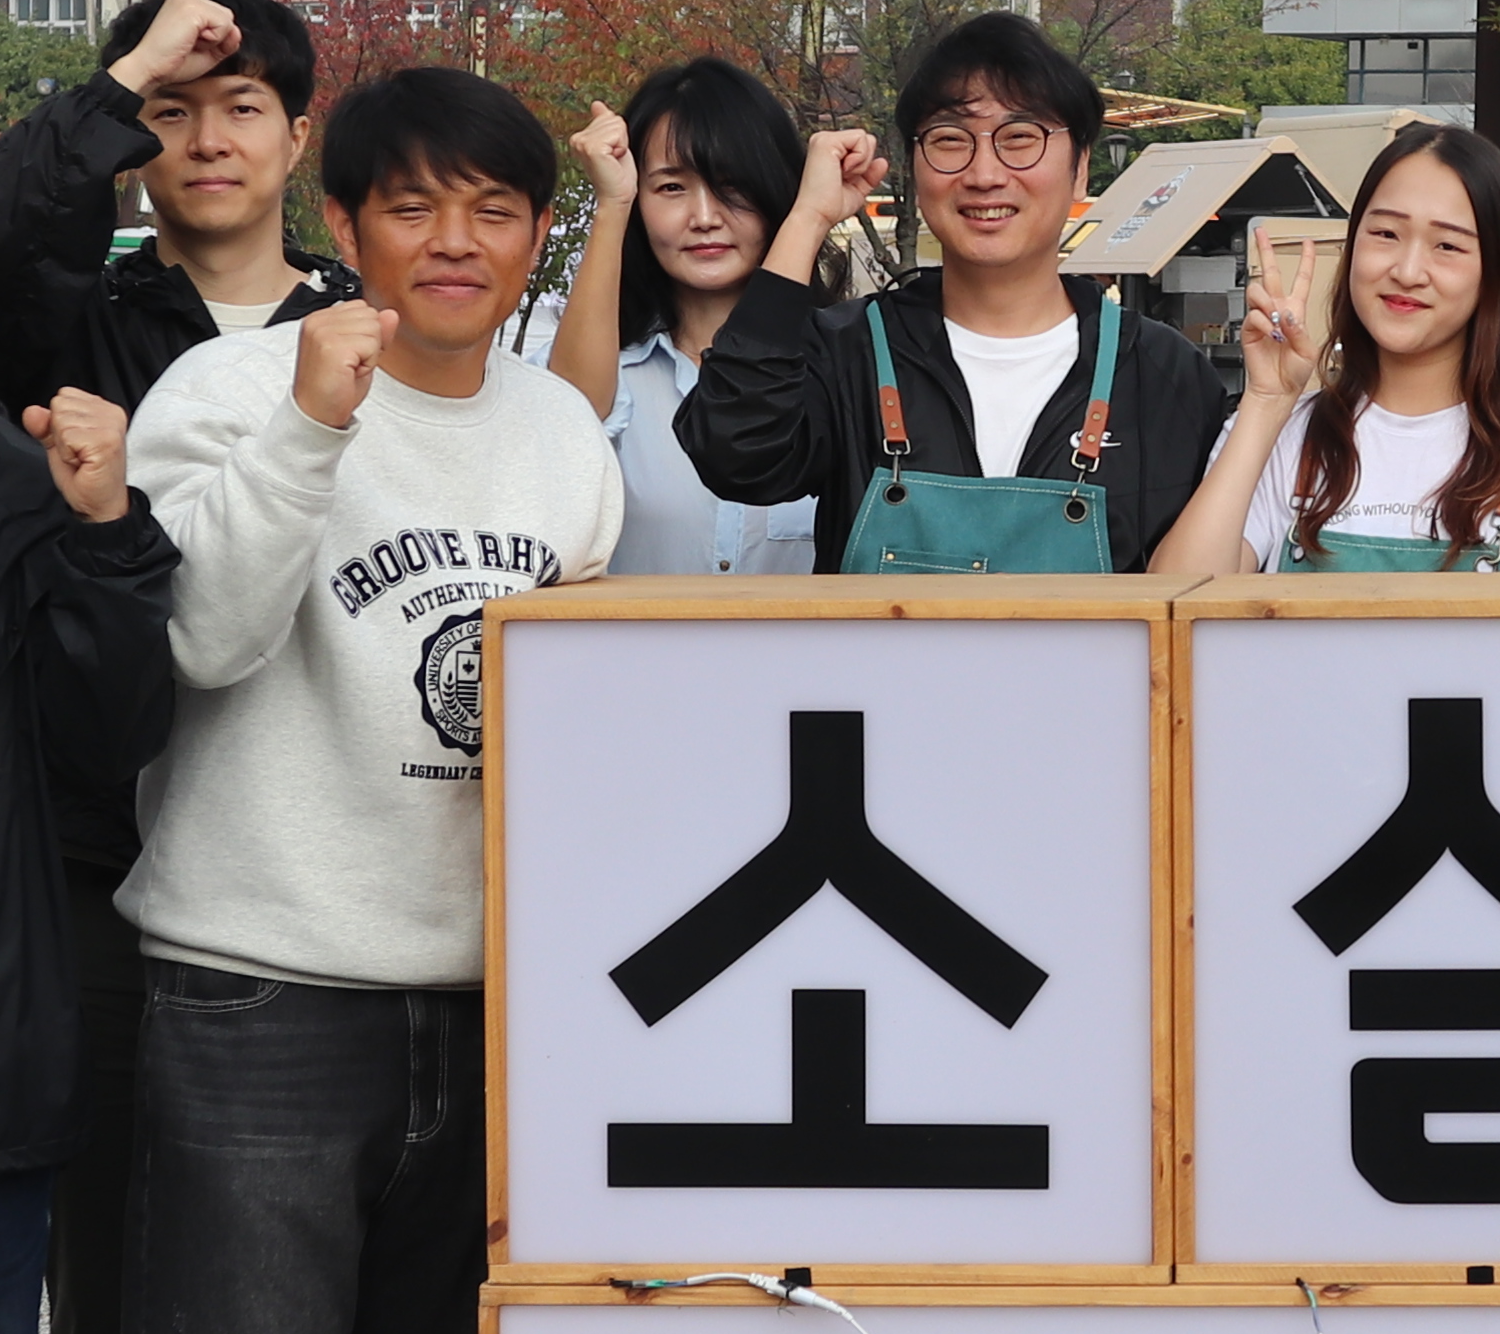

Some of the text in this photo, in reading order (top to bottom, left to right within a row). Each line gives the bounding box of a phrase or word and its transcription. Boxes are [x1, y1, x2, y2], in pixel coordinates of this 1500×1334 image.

[1362, 502, 1416, 516] WITHOUT
[329, 528, 470, 618] GROOVE
[401, 581, 493, 624] AUTHENTIC
[428, 625, 464, 692] UNIVERSITY
[435, 708, 470, 743] SPORTS
[401, 762, 468, 780] LEGENDARY
